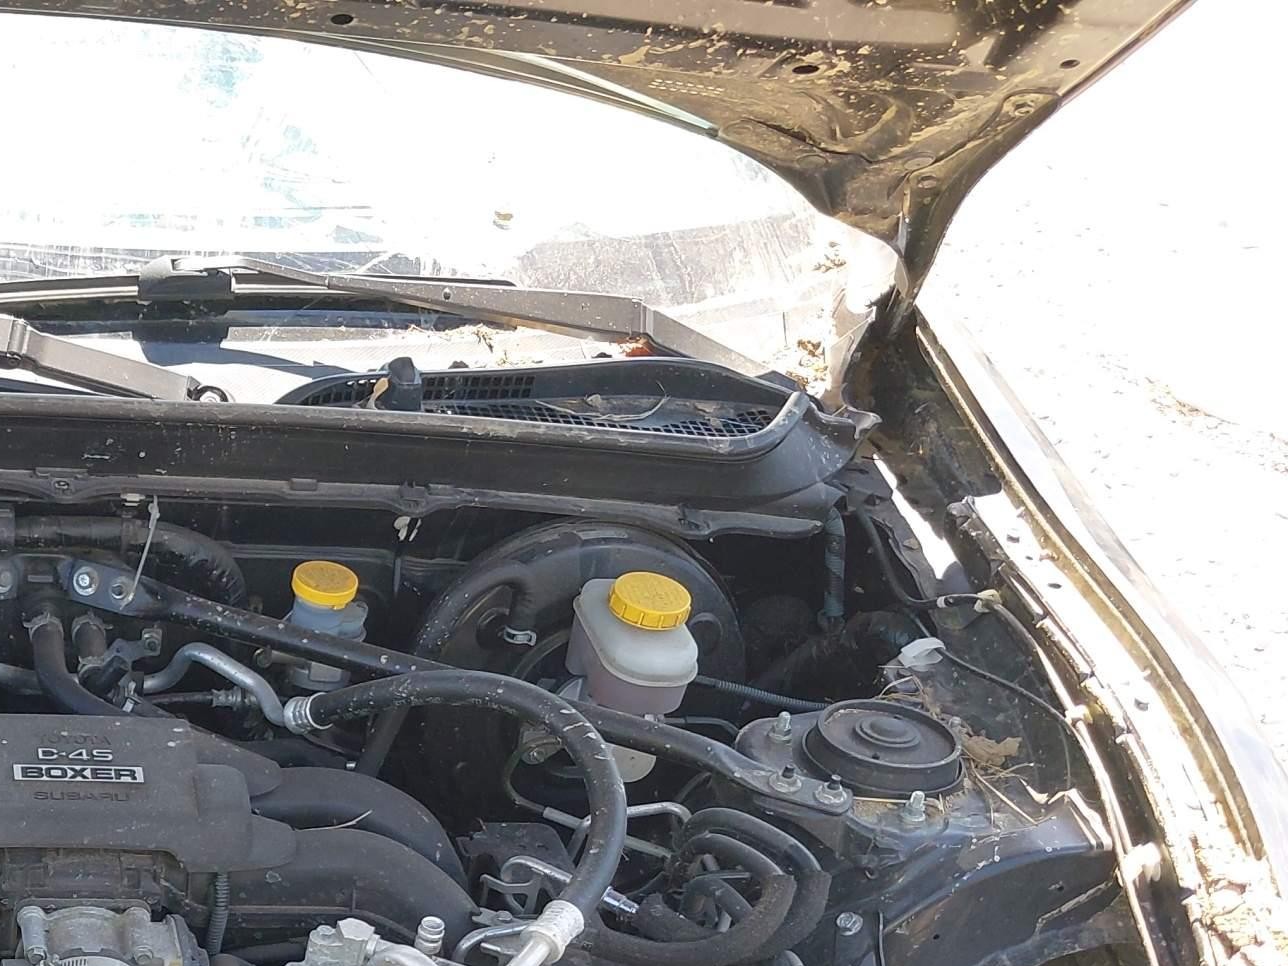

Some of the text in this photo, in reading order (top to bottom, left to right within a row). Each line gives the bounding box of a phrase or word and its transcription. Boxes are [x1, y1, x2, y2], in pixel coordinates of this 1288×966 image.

[37, 747, 114, 761] D-4S
[20, 766, 138, 781] BOXER
[33, 791, 130, 802] SUBARU
